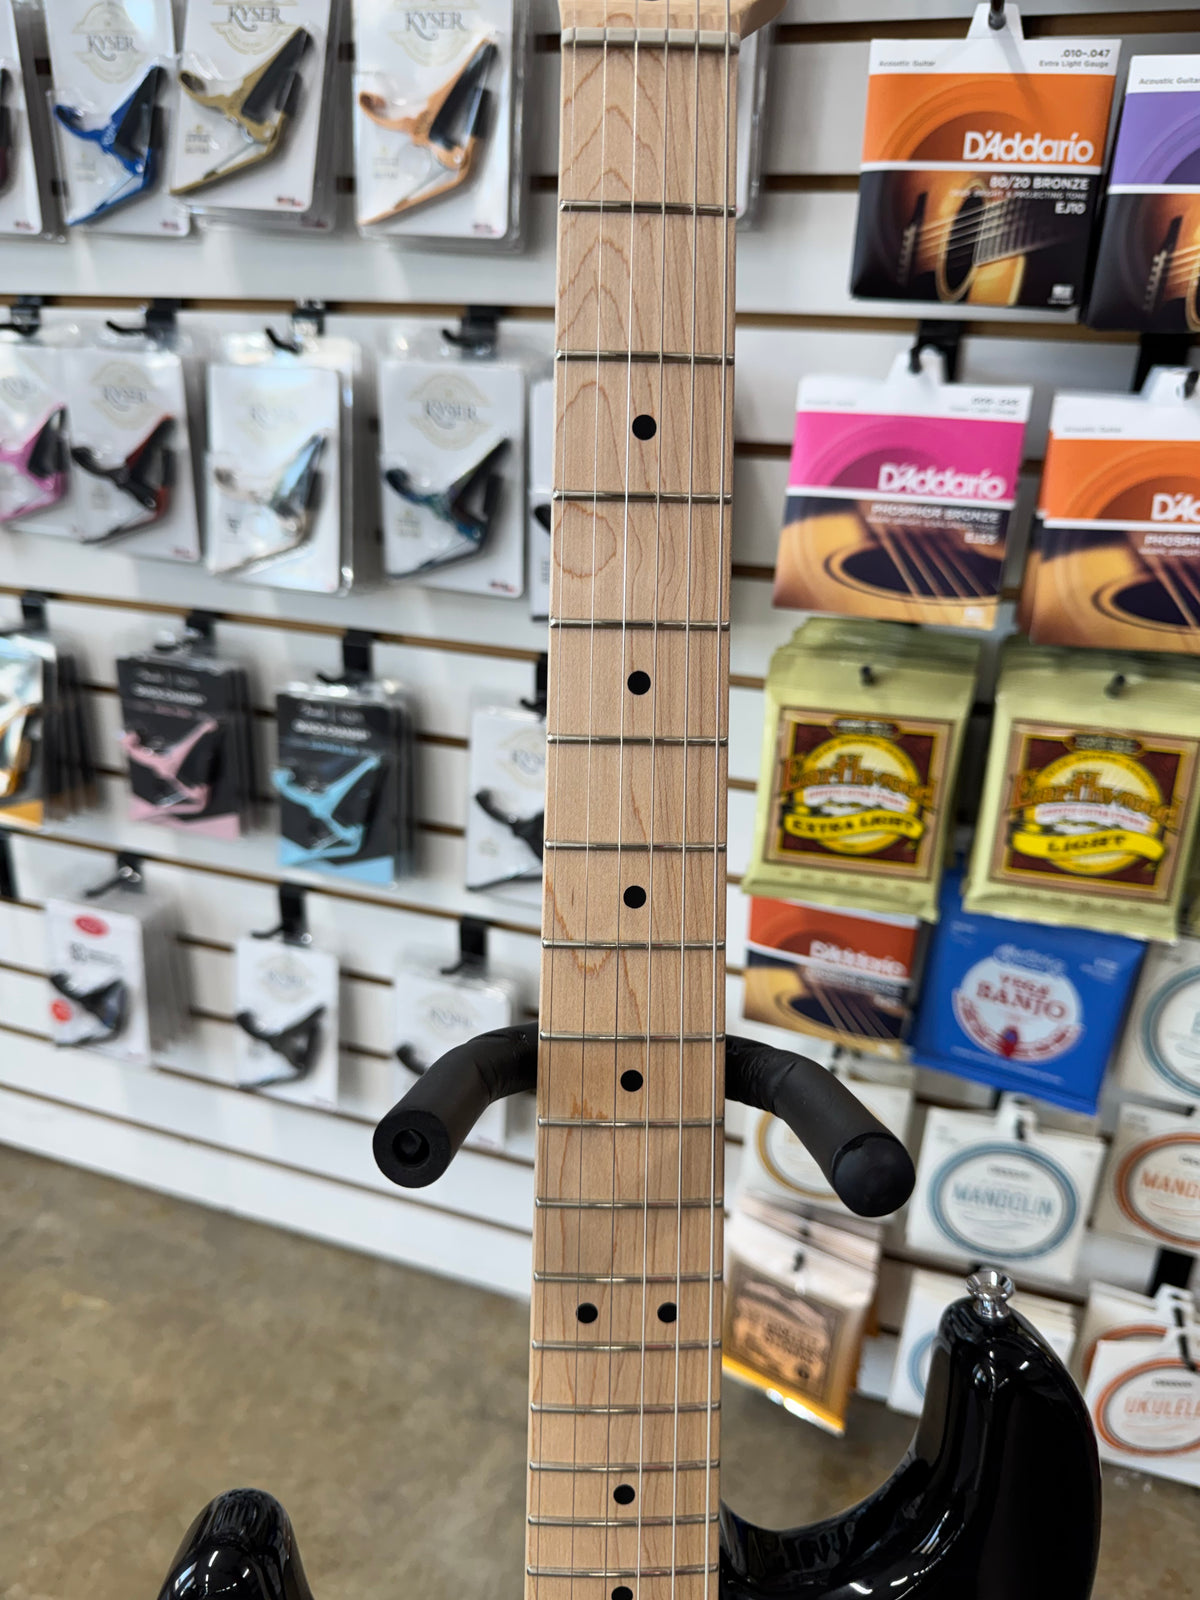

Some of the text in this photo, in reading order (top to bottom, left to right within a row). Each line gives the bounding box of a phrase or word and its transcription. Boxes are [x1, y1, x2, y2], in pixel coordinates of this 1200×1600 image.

[228, 7, 285, 32] KYSER
[405, 12, 469, 41] KYSER
[86, 35, 137, 62] KYSER
[1039, 60, 1109, 69] Extra Light Gauge
[962, 130, 1094, 163] D'Addario
[989, 174, 1090, 191] 80/20 BRONZE
[1054, 201, 1086, 215] EJ10
[793, 816, 914, 834] EXTRA LIGHT
[1047, 834, 1126, 853] LIGHT
[976, 980, 1068, 1020] BANJO
[952, 1182, 1056, 1219] MANDOLIN
